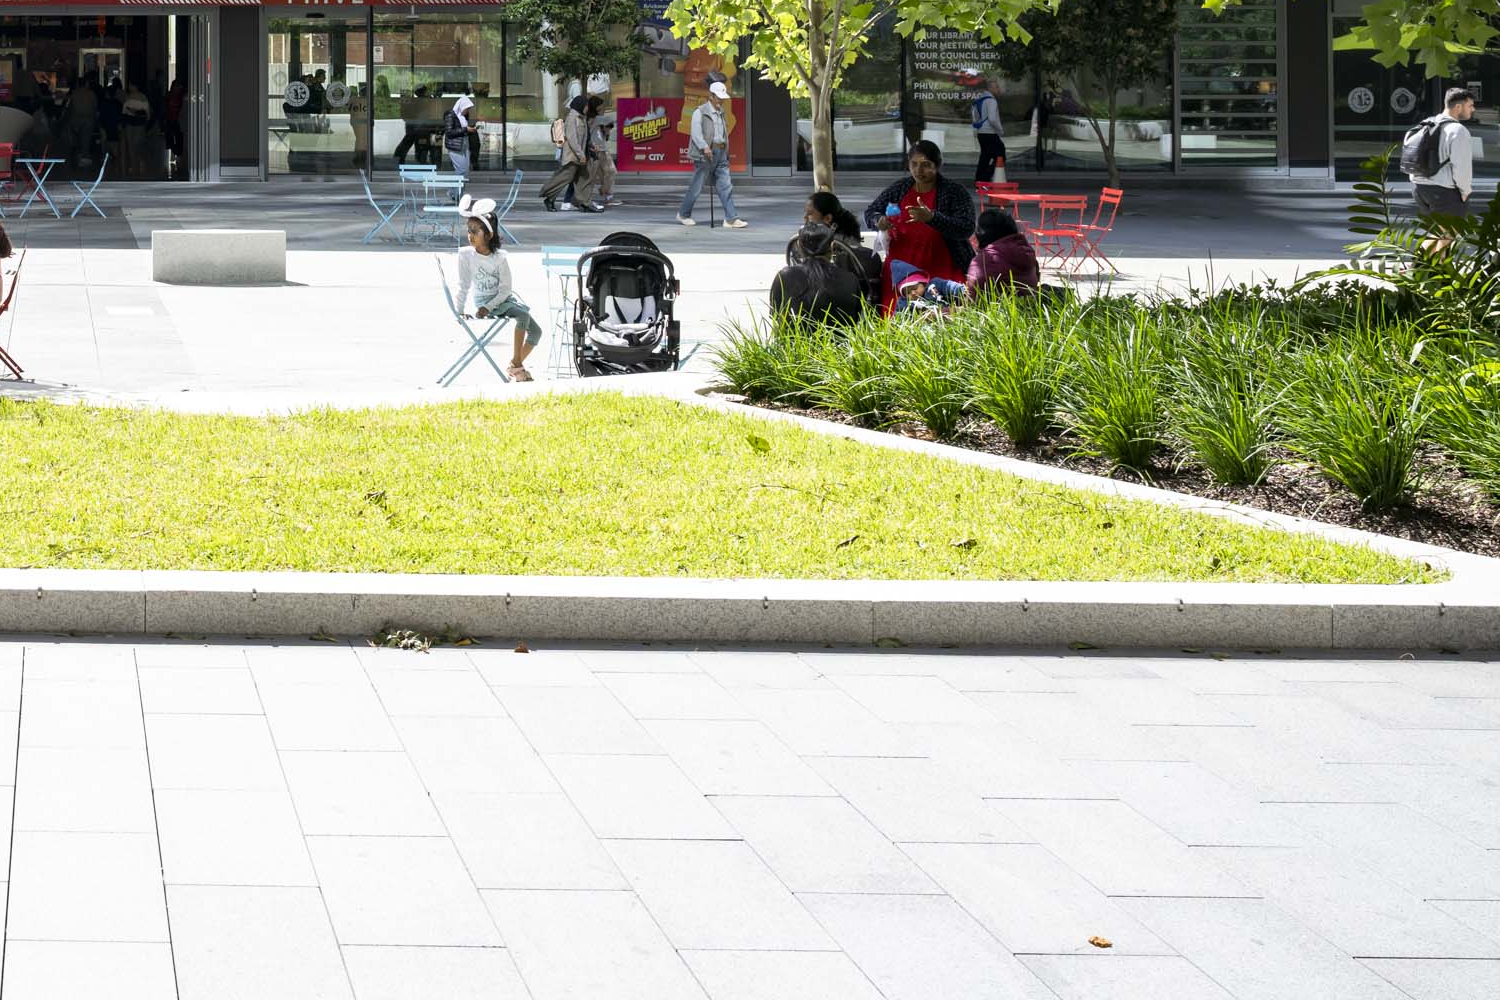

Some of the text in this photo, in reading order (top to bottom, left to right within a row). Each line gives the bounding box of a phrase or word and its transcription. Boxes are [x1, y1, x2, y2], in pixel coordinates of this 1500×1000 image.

[915, 41, 938, 49] YOUR
[915, 52, 938, 60] YOUR
[940, 52, 978, 60] COUNCIL
[915, 62, 938, 70] YOUR
[914, 92, 935, 100] FIND
[936, 92, 960, 100] YOUR
[622, 116, 668, 136] BRICKMAN
[632, 128, 659, 141] CITIES
[648, 153, 665, 161] CITY
